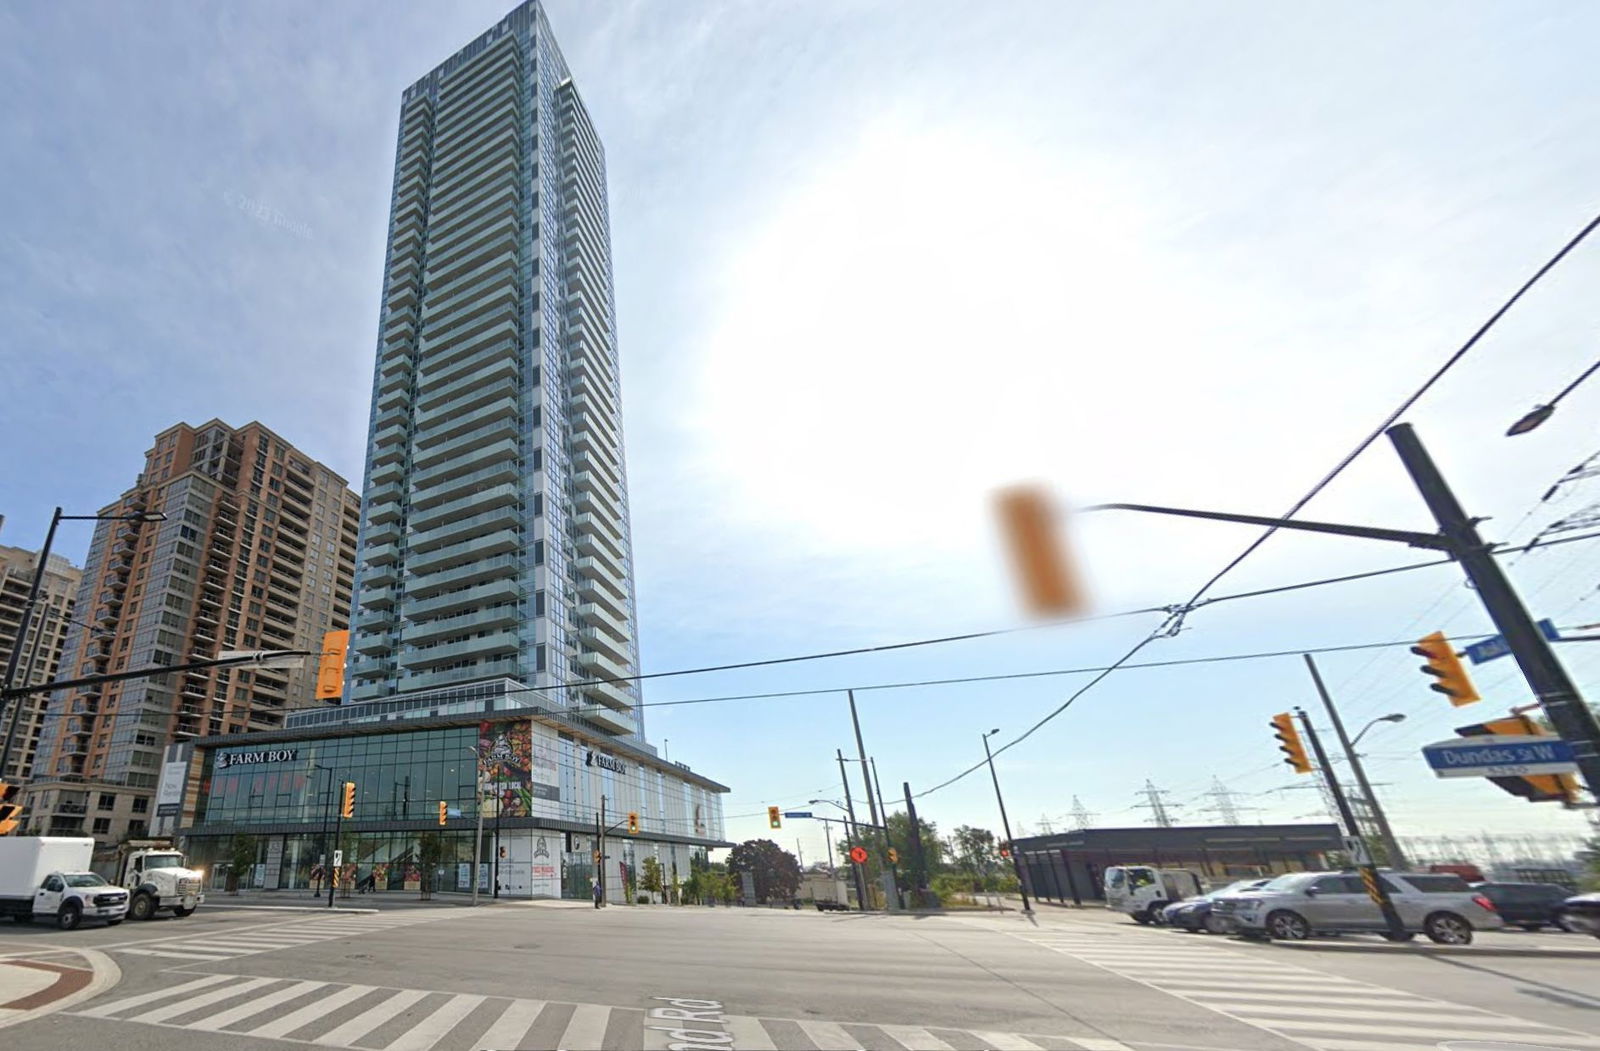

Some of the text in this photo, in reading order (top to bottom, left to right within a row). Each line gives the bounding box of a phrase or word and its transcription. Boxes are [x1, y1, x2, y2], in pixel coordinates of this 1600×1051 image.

[229, 749, 296, 765] FARM BOY
[1442, 748, 1515, 764] Dundas
[1536, 745, 1555, 759] W
[598, 755, 616, 771] FARM
